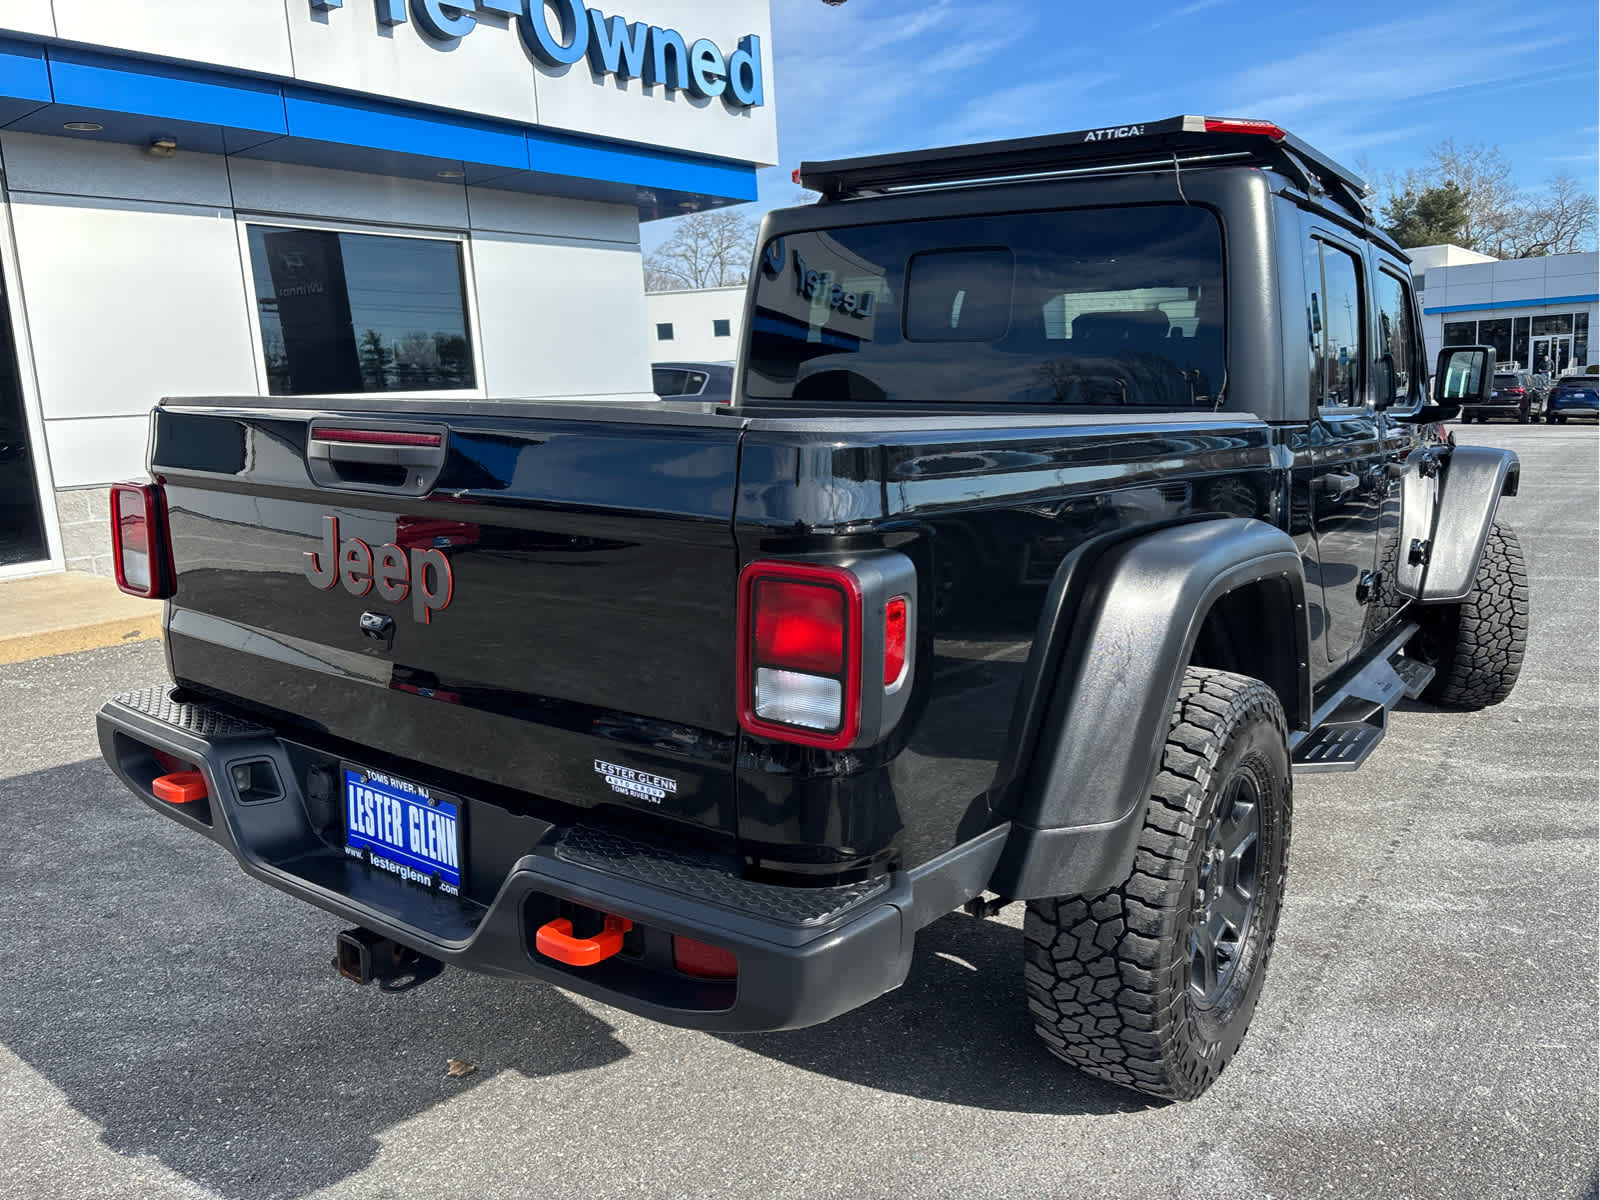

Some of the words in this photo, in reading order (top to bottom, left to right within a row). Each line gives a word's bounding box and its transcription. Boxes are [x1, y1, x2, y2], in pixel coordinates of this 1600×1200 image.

[309, 0, 764, 107] e-Owned
[1084, 126, 1140, 142] ATTICA
[303, 515, 453, 625] Jeep
[366, 770, 389, 785] TOMS
[418, 787, 430, 798] NJ
[594, 760, 636, 780] LESTER
[638, 773, 677, 791] GLENN
[611, 785, 629, 796] TOMS
[348, 784, 404, 848] LESTER
[408, 804, 459, 869] GLENN
[344, 846, 364, 860] www.
[370, 853, 432, 887] lesterglenn
[439, 882, 459, 896] .com
